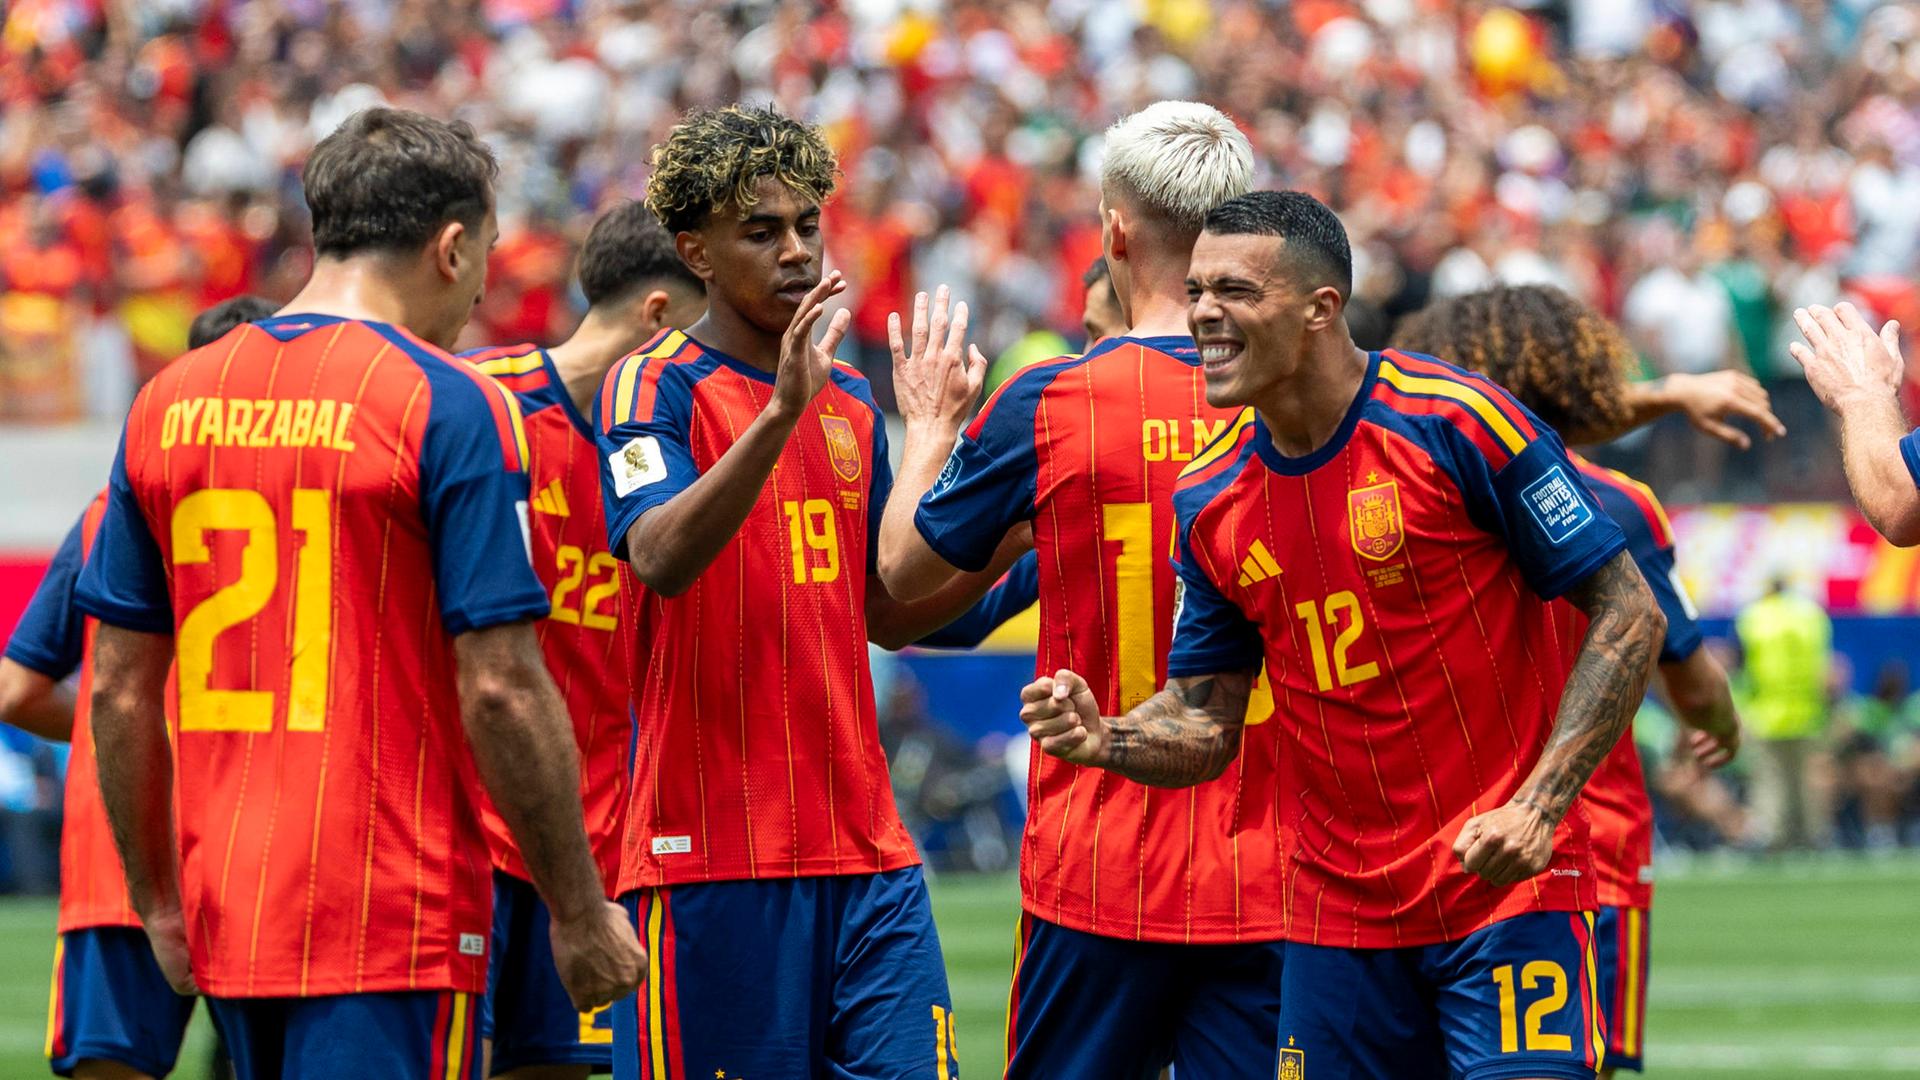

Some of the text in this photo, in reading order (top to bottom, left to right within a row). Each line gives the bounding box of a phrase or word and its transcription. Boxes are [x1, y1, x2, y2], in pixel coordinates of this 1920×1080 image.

[161, 397, 355, 451] OYARZABAL
[1143, 419, 1226, 461] OLM
[1531, 476, 1564, 503] FOOTBALL
[1538, 484, 1571, 514] UNITES
[1545, 513, 1560, 526] the
[784, 499, 840, 584] 19
[171, 488, 331, 732] 21
[548, 544, 620, 631] 22
[1295, 590, 1380, 692] 12
[1492, 960, 1572, 1053] 12
